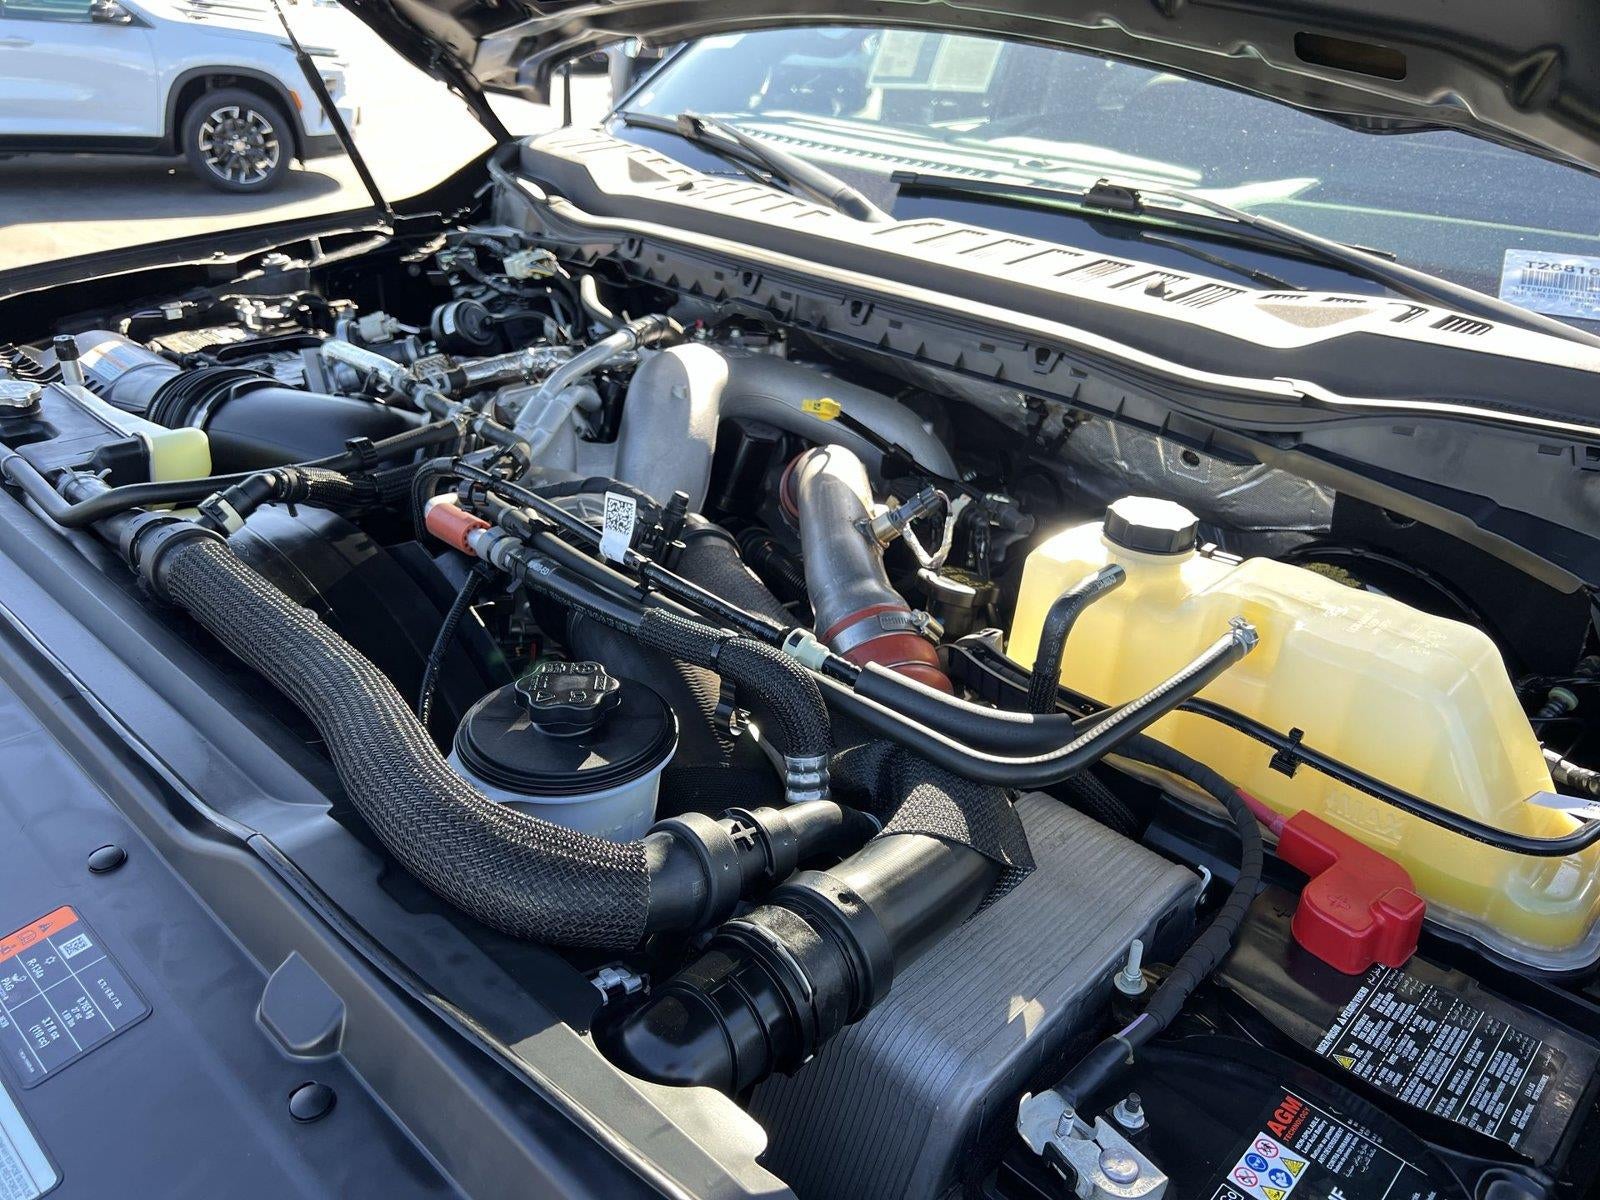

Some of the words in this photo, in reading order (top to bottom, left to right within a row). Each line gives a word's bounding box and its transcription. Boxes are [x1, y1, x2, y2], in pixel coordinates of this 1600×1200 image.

[25, 957, 46, 979] R-134a
[0, 976, 15, 992] PAG
[1267, 1094, 1304, 1138] AGM
[1283, 1106, 1310, 1143] TECHNOLOGY
